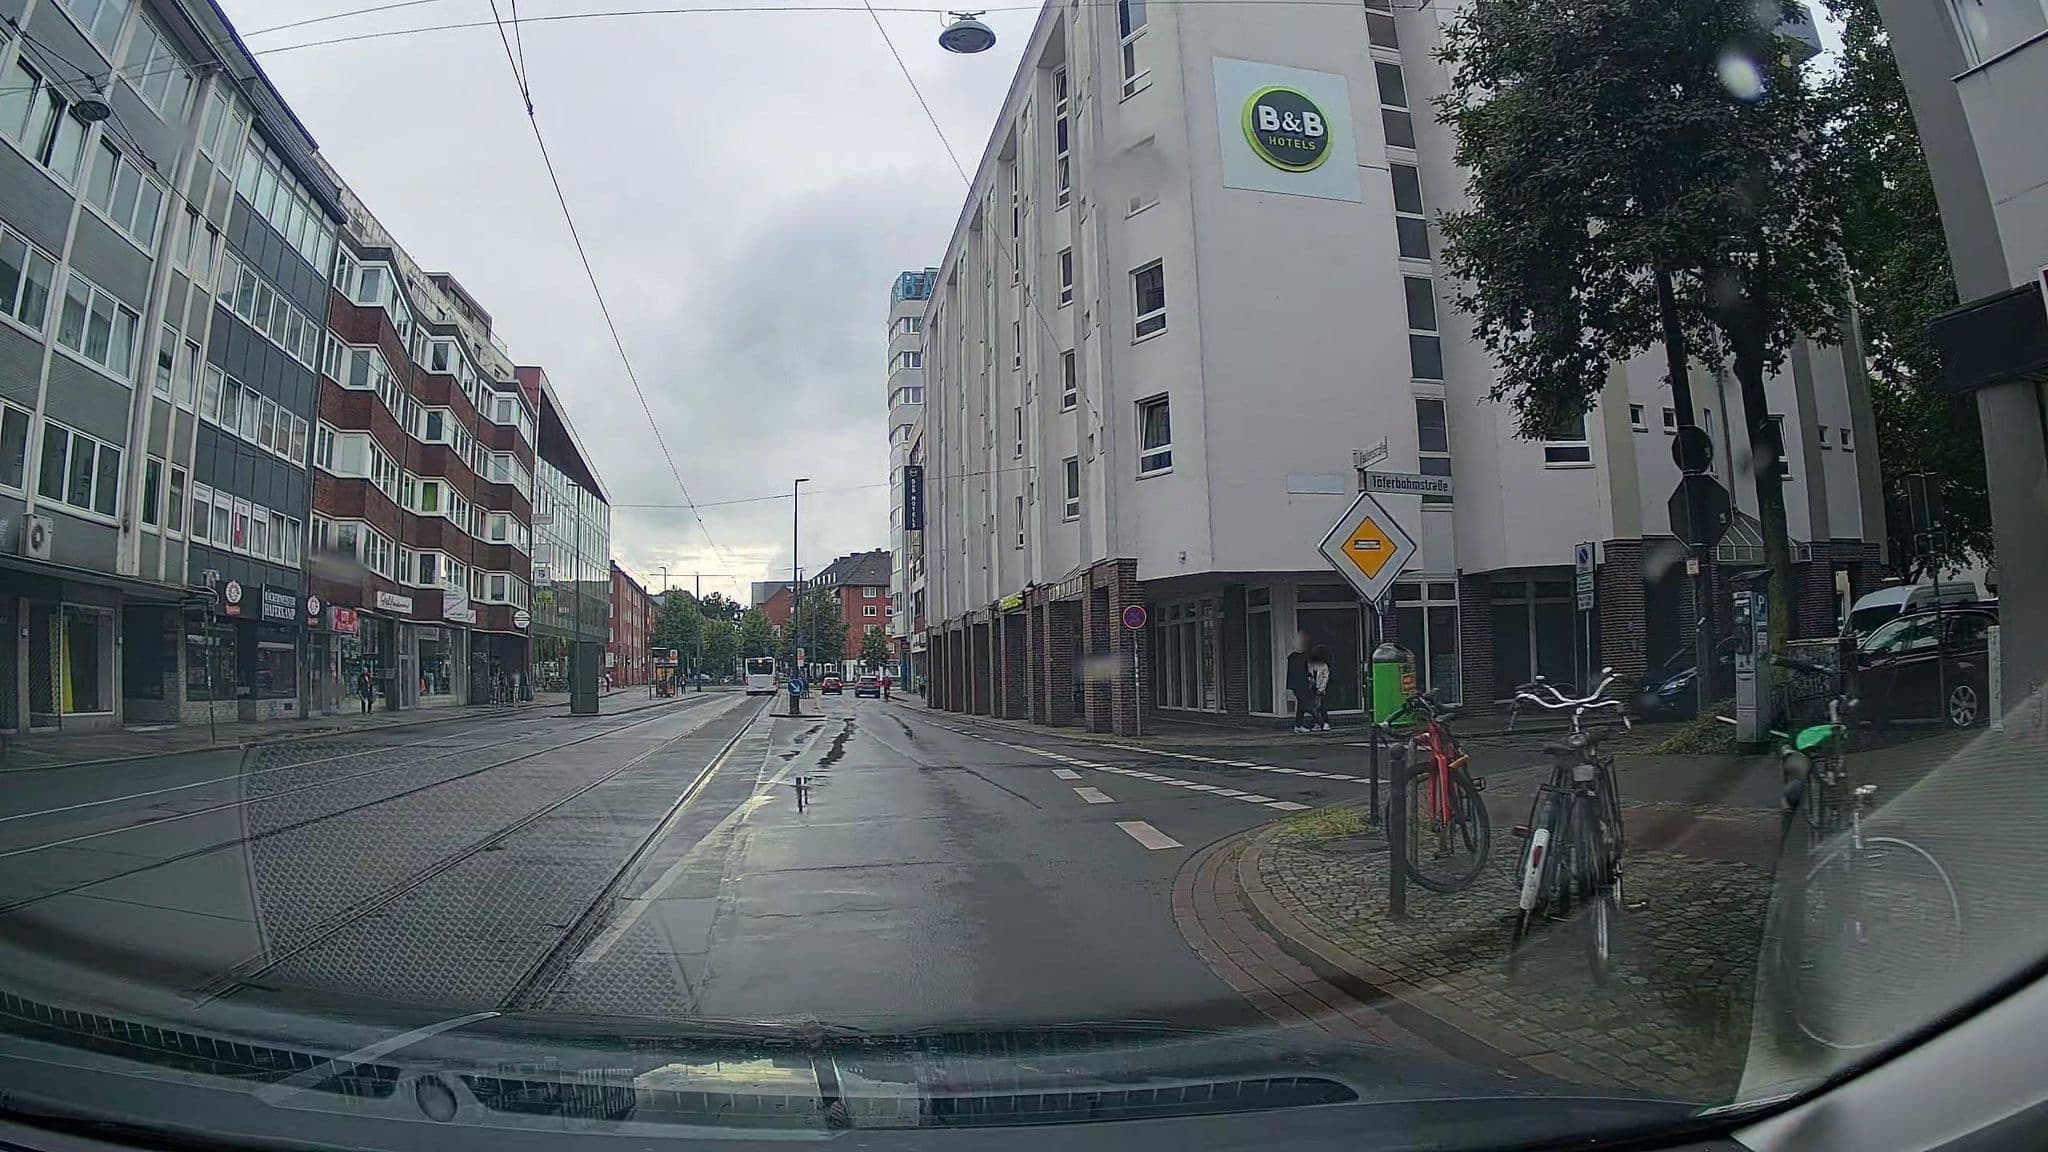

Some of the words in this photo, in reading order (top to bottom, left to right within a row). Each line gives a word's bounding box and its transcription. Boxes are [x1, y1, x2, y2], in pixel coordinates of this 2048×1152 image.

[1258, 105, 1324, 137] B&B
[1269, 136, 1316, 150] HOTELS
[1371, 475, 1448, 491] Töferbohmstraße
